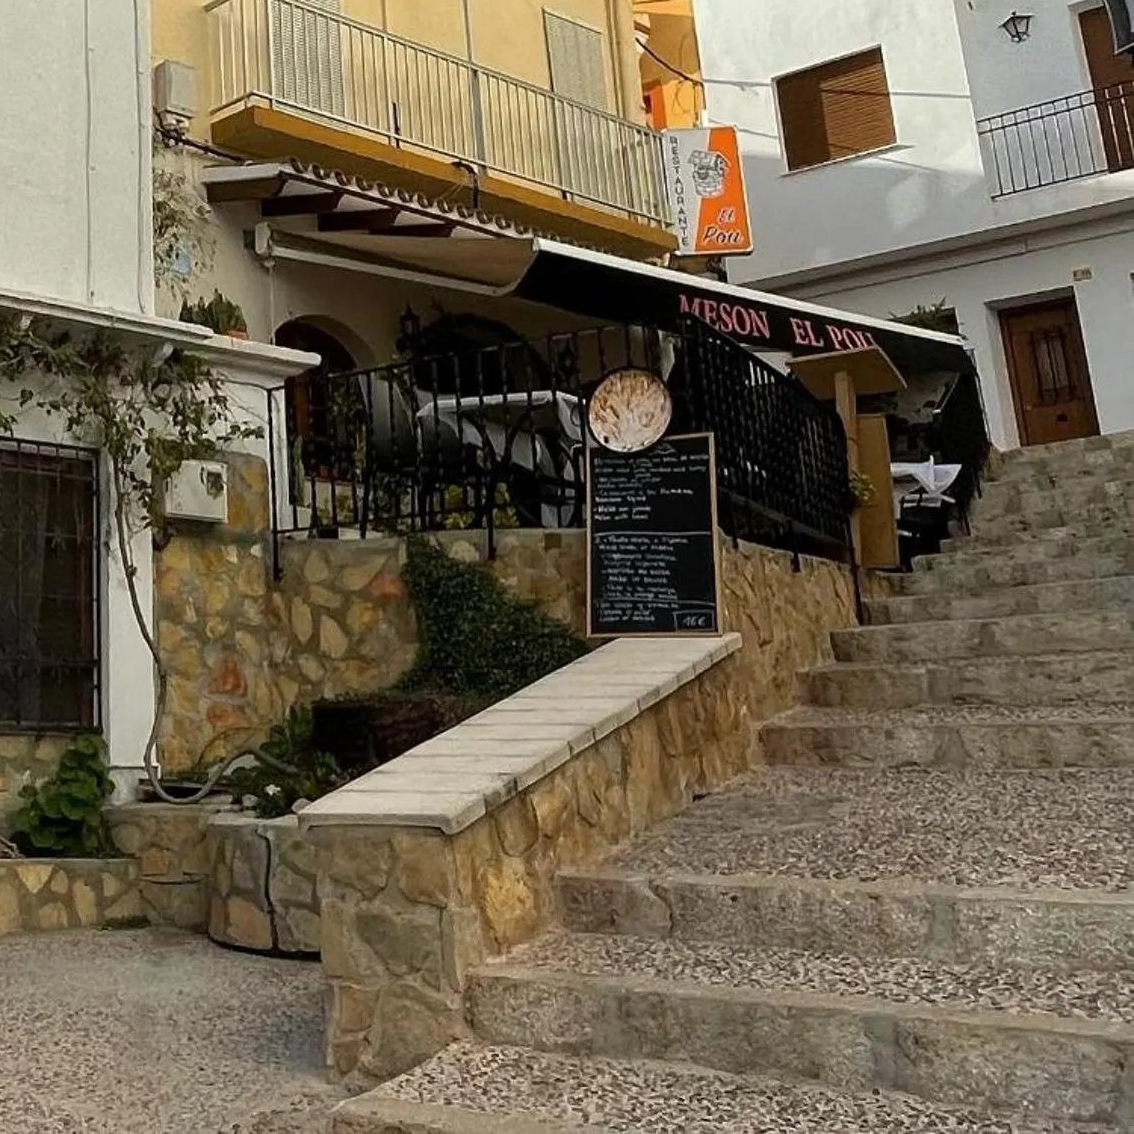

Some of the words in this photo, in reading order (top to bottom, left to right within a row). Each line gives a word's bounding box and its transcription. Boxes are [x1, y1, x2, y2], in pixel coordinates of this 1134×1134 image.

[669, 135, 689, 246] RESTAURANTE
[718, 207, 734, 223] El
[704, 226, 742, 244] Pou
[678, 293, 770, 339] MESON
[789, 316, 825, 348] EL
